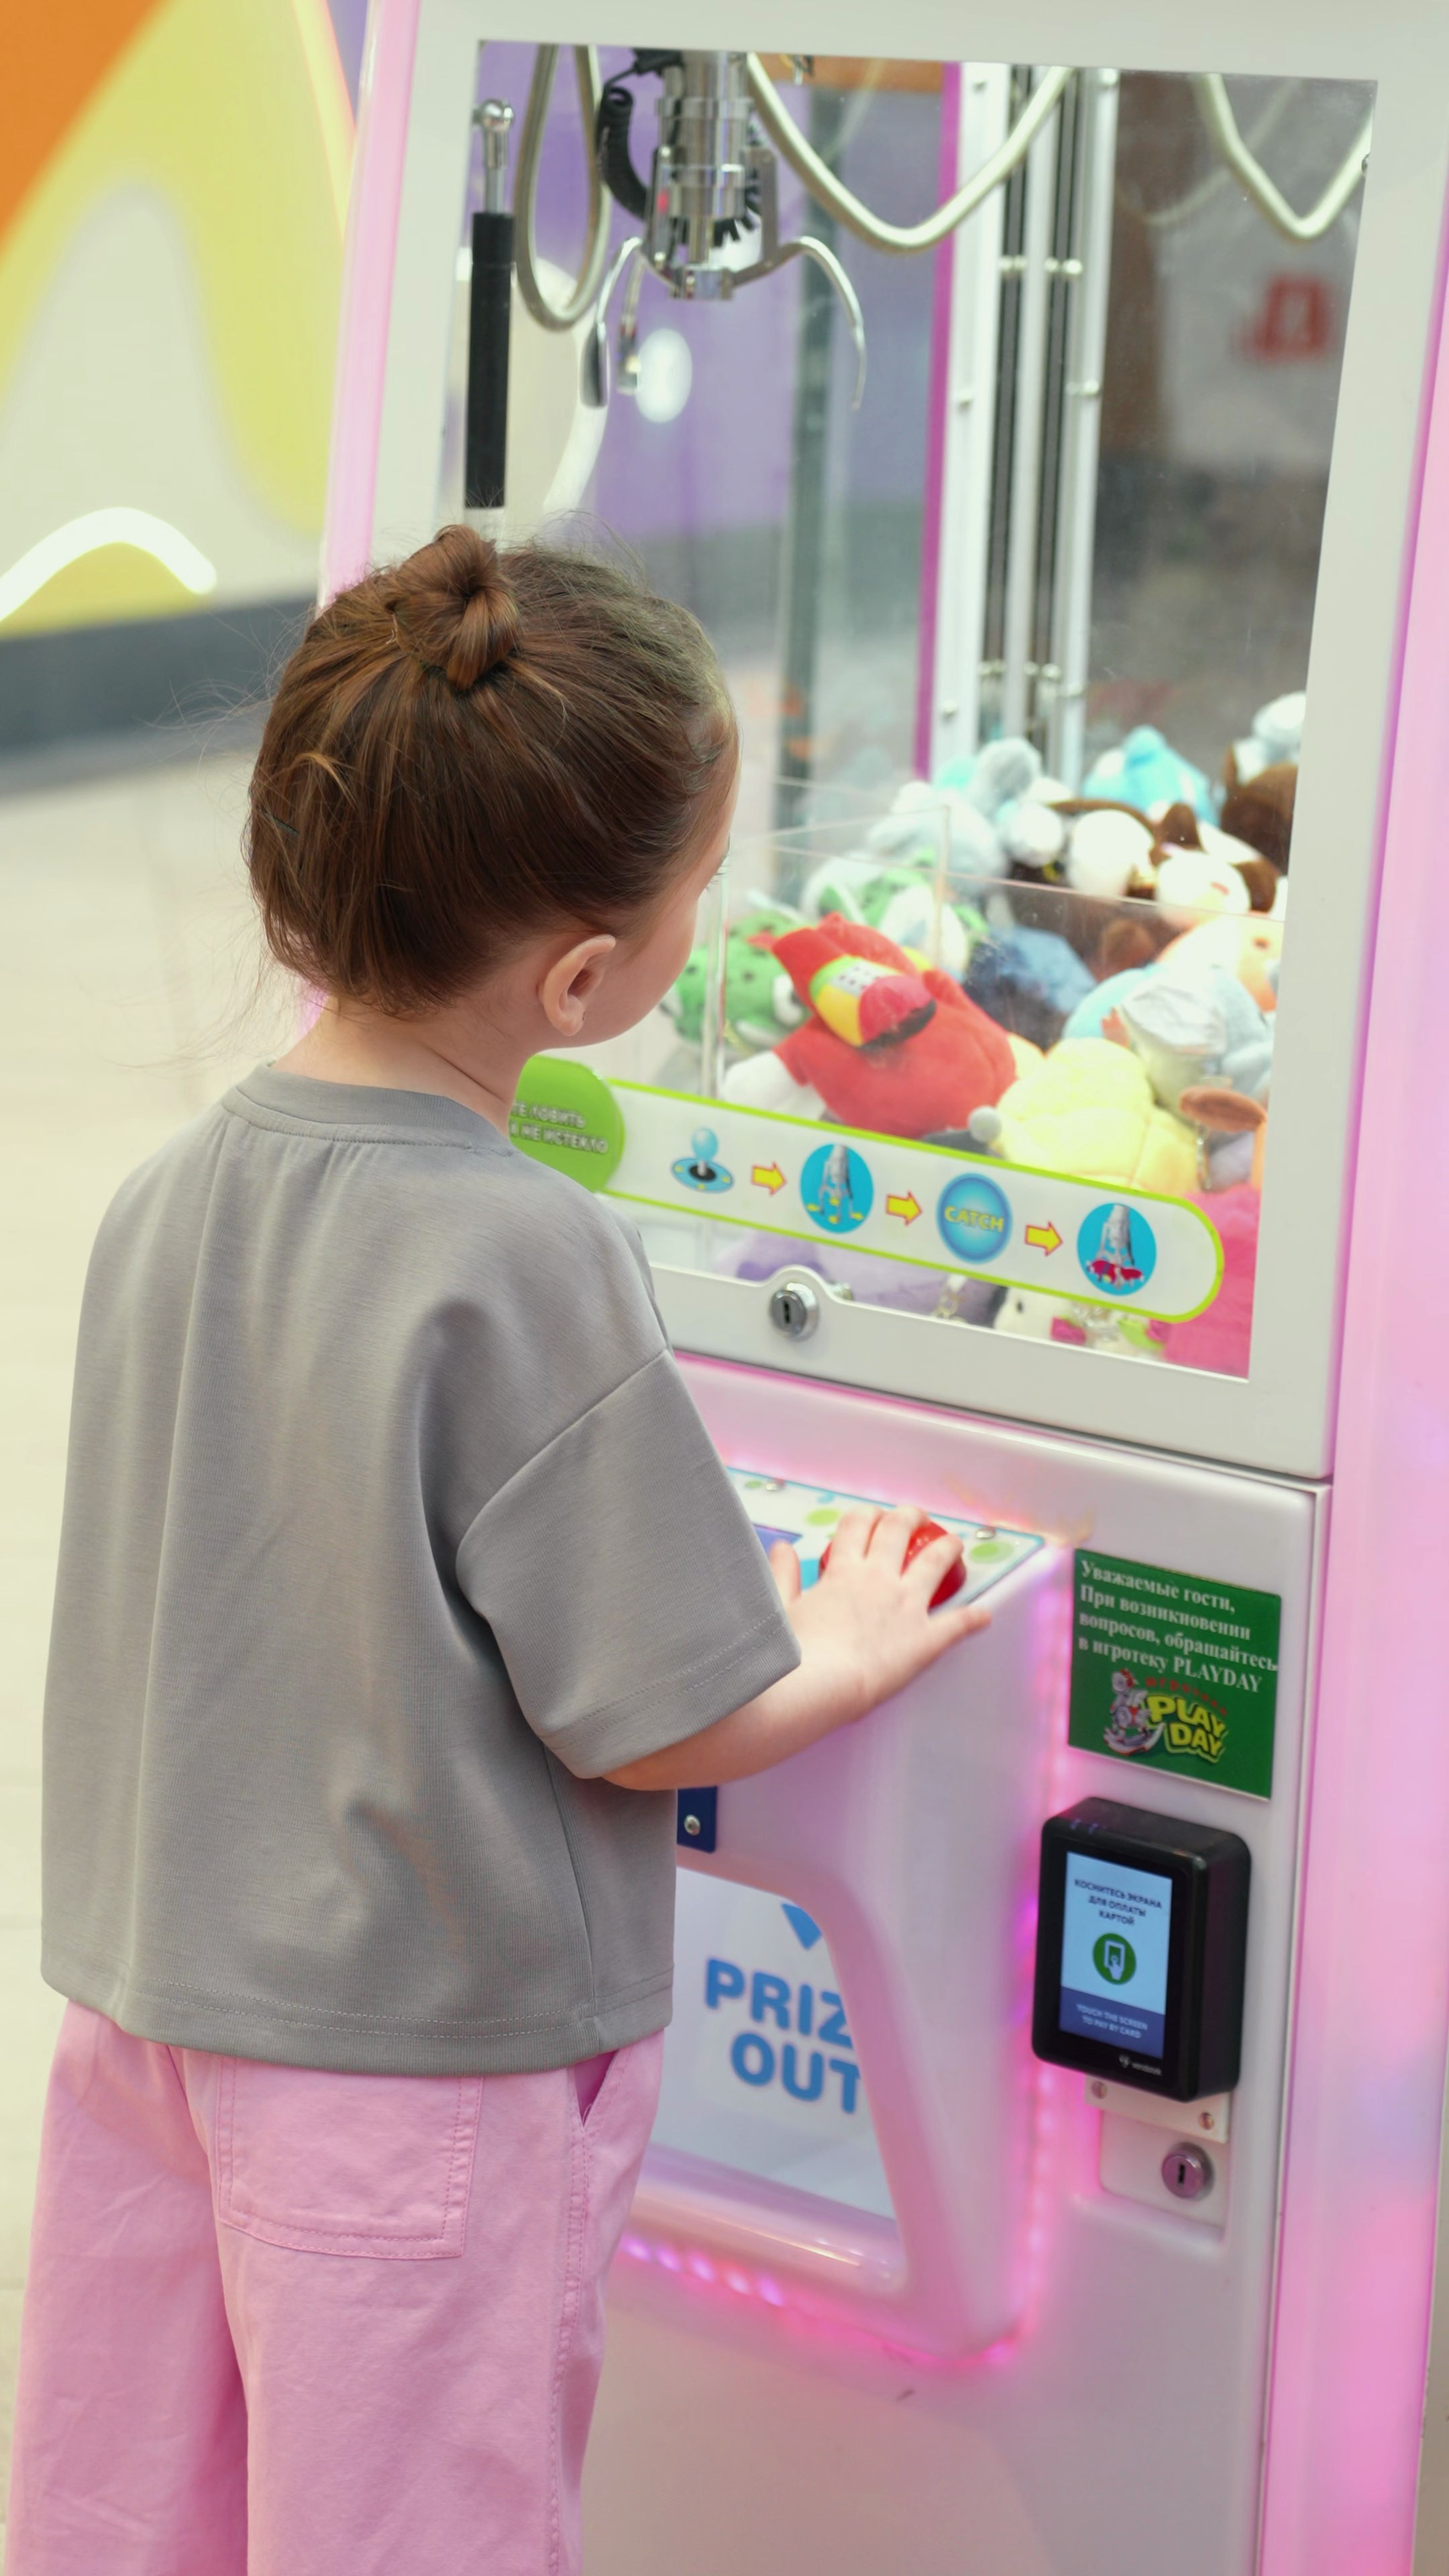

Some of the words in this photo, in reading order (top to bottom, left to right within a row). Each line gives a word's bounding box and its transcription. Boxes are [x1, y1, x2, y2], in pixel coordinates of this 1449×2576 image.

[521, 1122, 541, 1142] НЕ
[543, 1127, 608, 1154] ИСТЕКЛО
[945, 1205, 1004, 1234] CATCH
[1081, 1559, 1180, 1599] Уважаемые
[1183, 1588, 1236, 1615] гости,
[1079, 1611, 1161, 1647] вопросов,
[1080, 1584, 1116, 1609] При
[1119, 1597, 1251, 1641] возникновении
[1078, 1636, 1089, 1651] в
[1092, 1640, 1169, 1674] игротеку
[1173, 1655, 1263, 1693] PLAYDAY
[1146, 1695, 1226, 1739] PLAY
[1169, 1721, 1223, 1758] DAY
[704, 1957, 853, 2050] PRIZ
[730, 2031, 861, 2114] OUT
